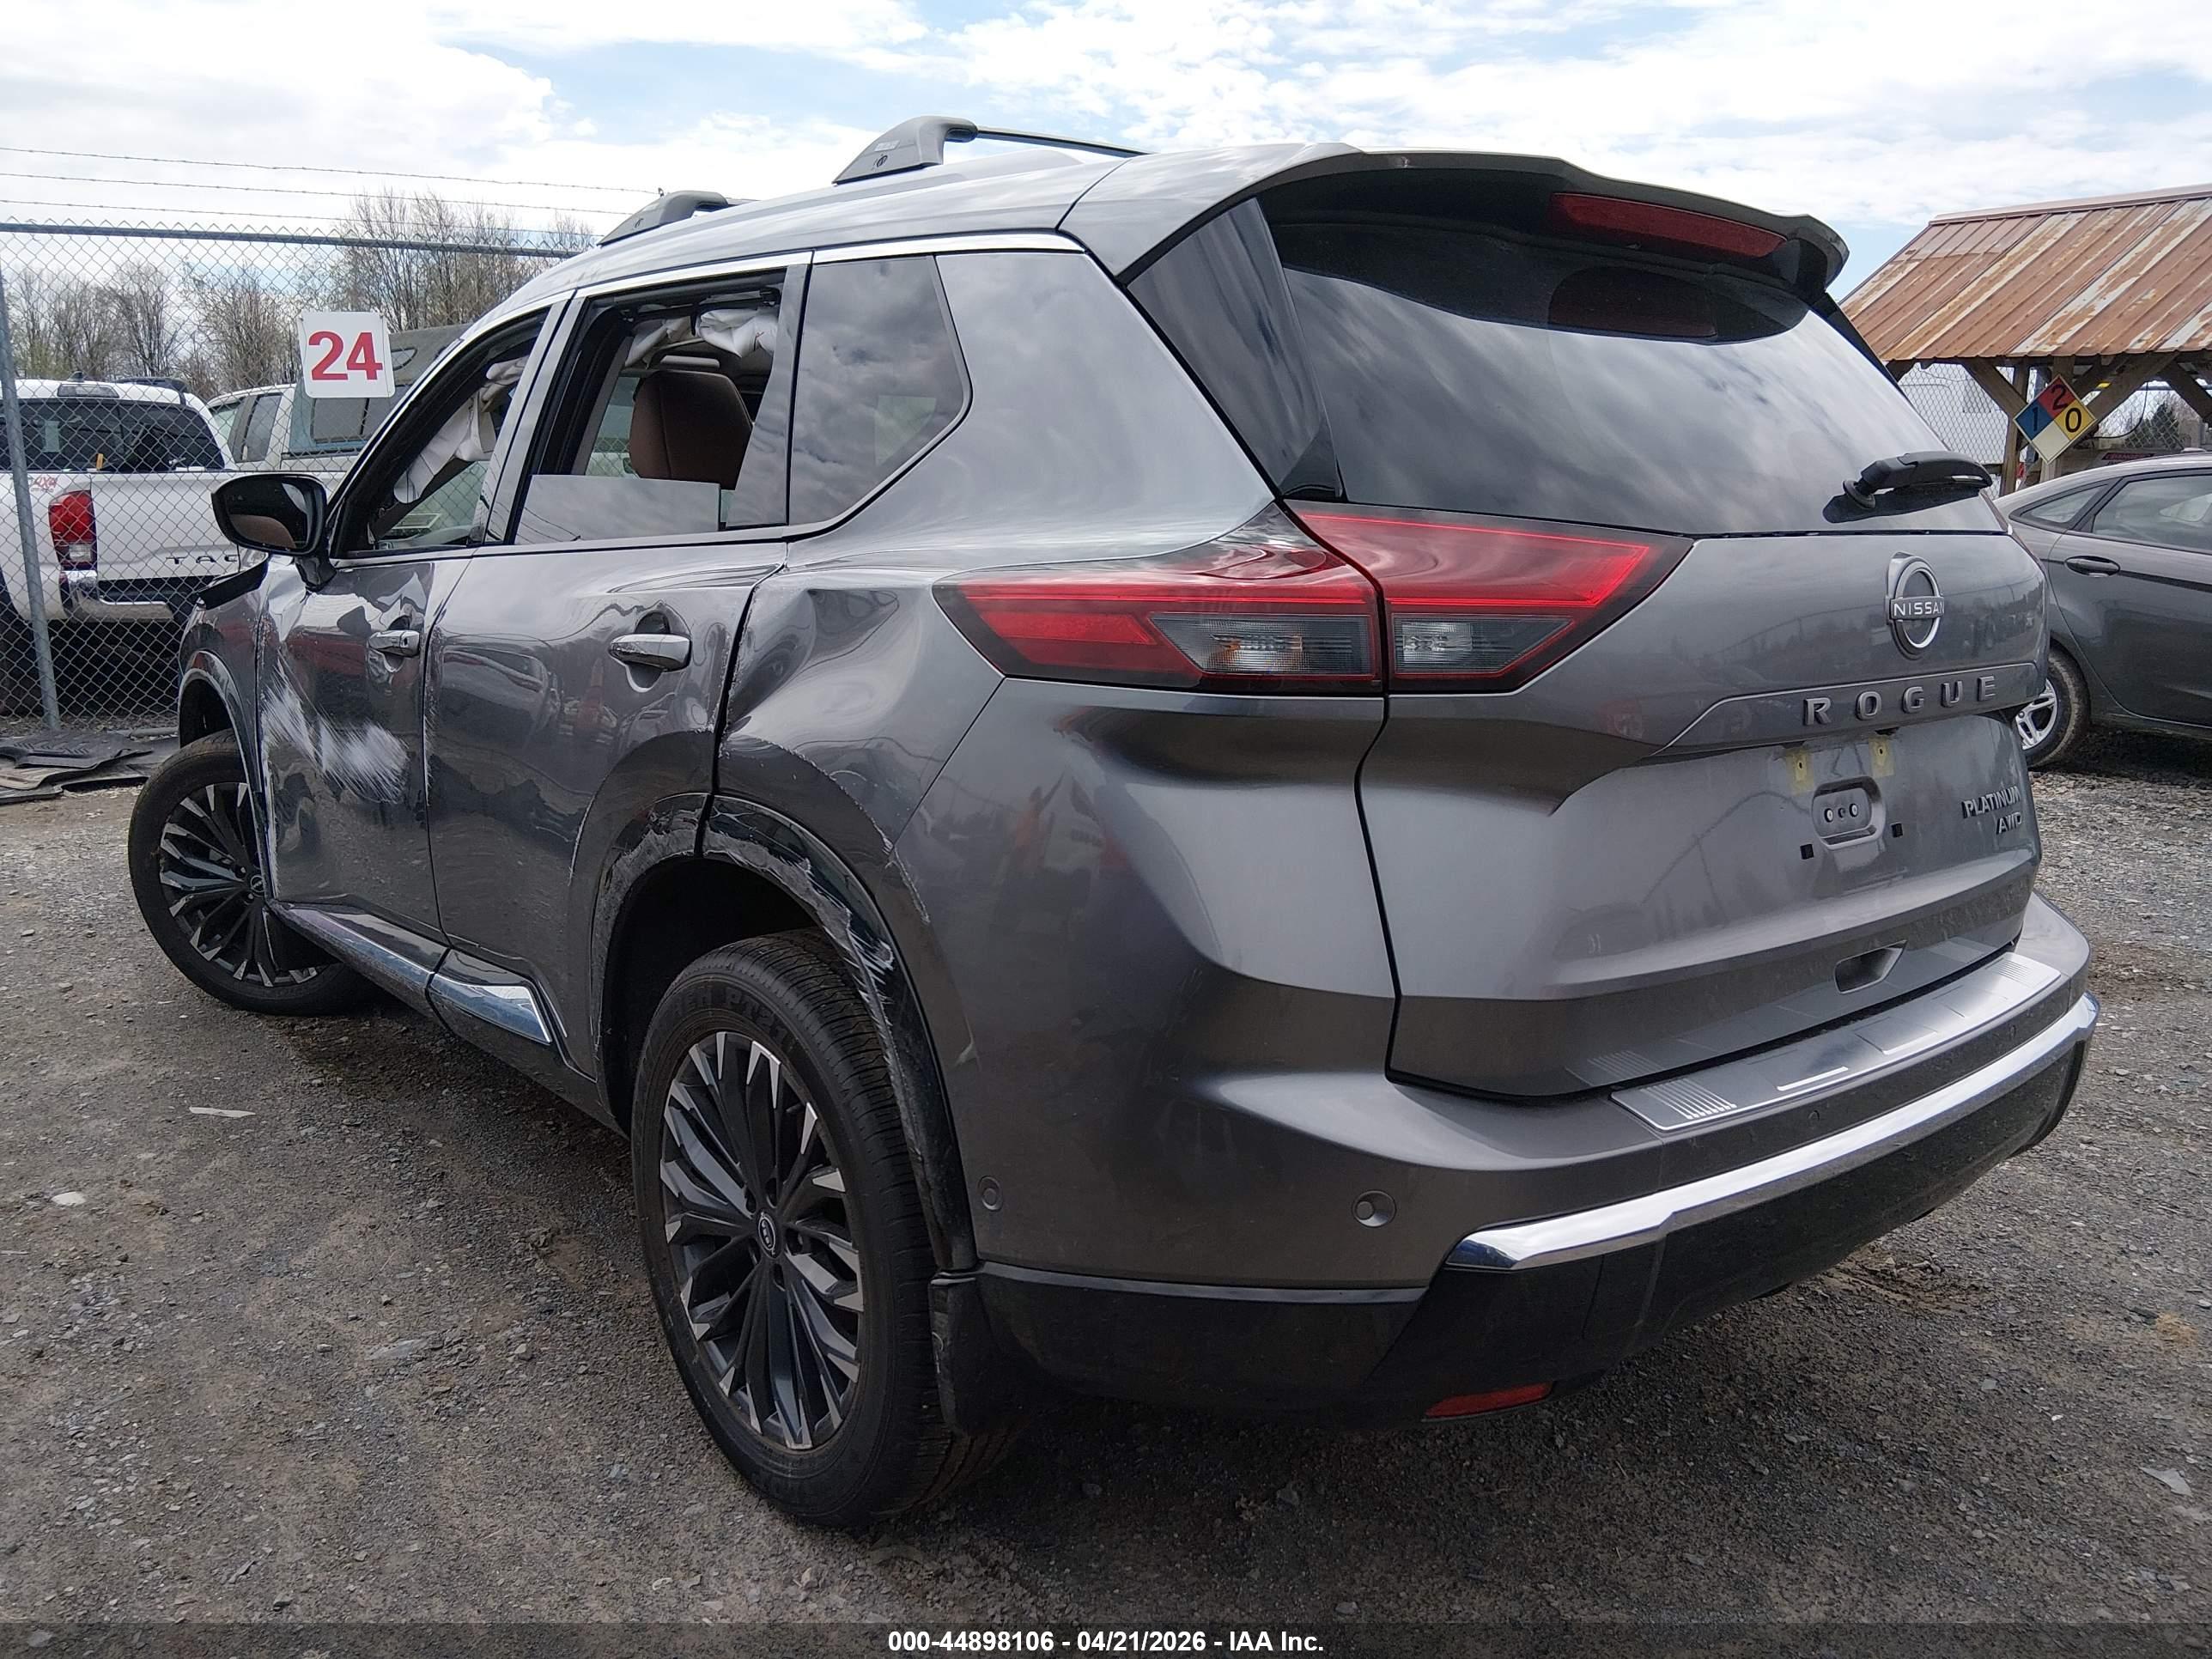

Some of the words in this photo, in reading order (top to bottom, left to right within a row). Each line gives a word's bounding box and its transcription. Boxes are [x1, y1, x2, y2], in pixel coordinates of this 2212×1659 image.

[307, 331, 384, 380] 24
[2051, 384, 2070, 410] 2
[2032, 407, 2039, 431] 1
[2065, 407, 2082, 434] 0
[1893, 601, 1945, 617] NISSAN
[1803, 674, 1997, 726] ROGUE
[1961, 786, 2021, 818] PLATINUM
